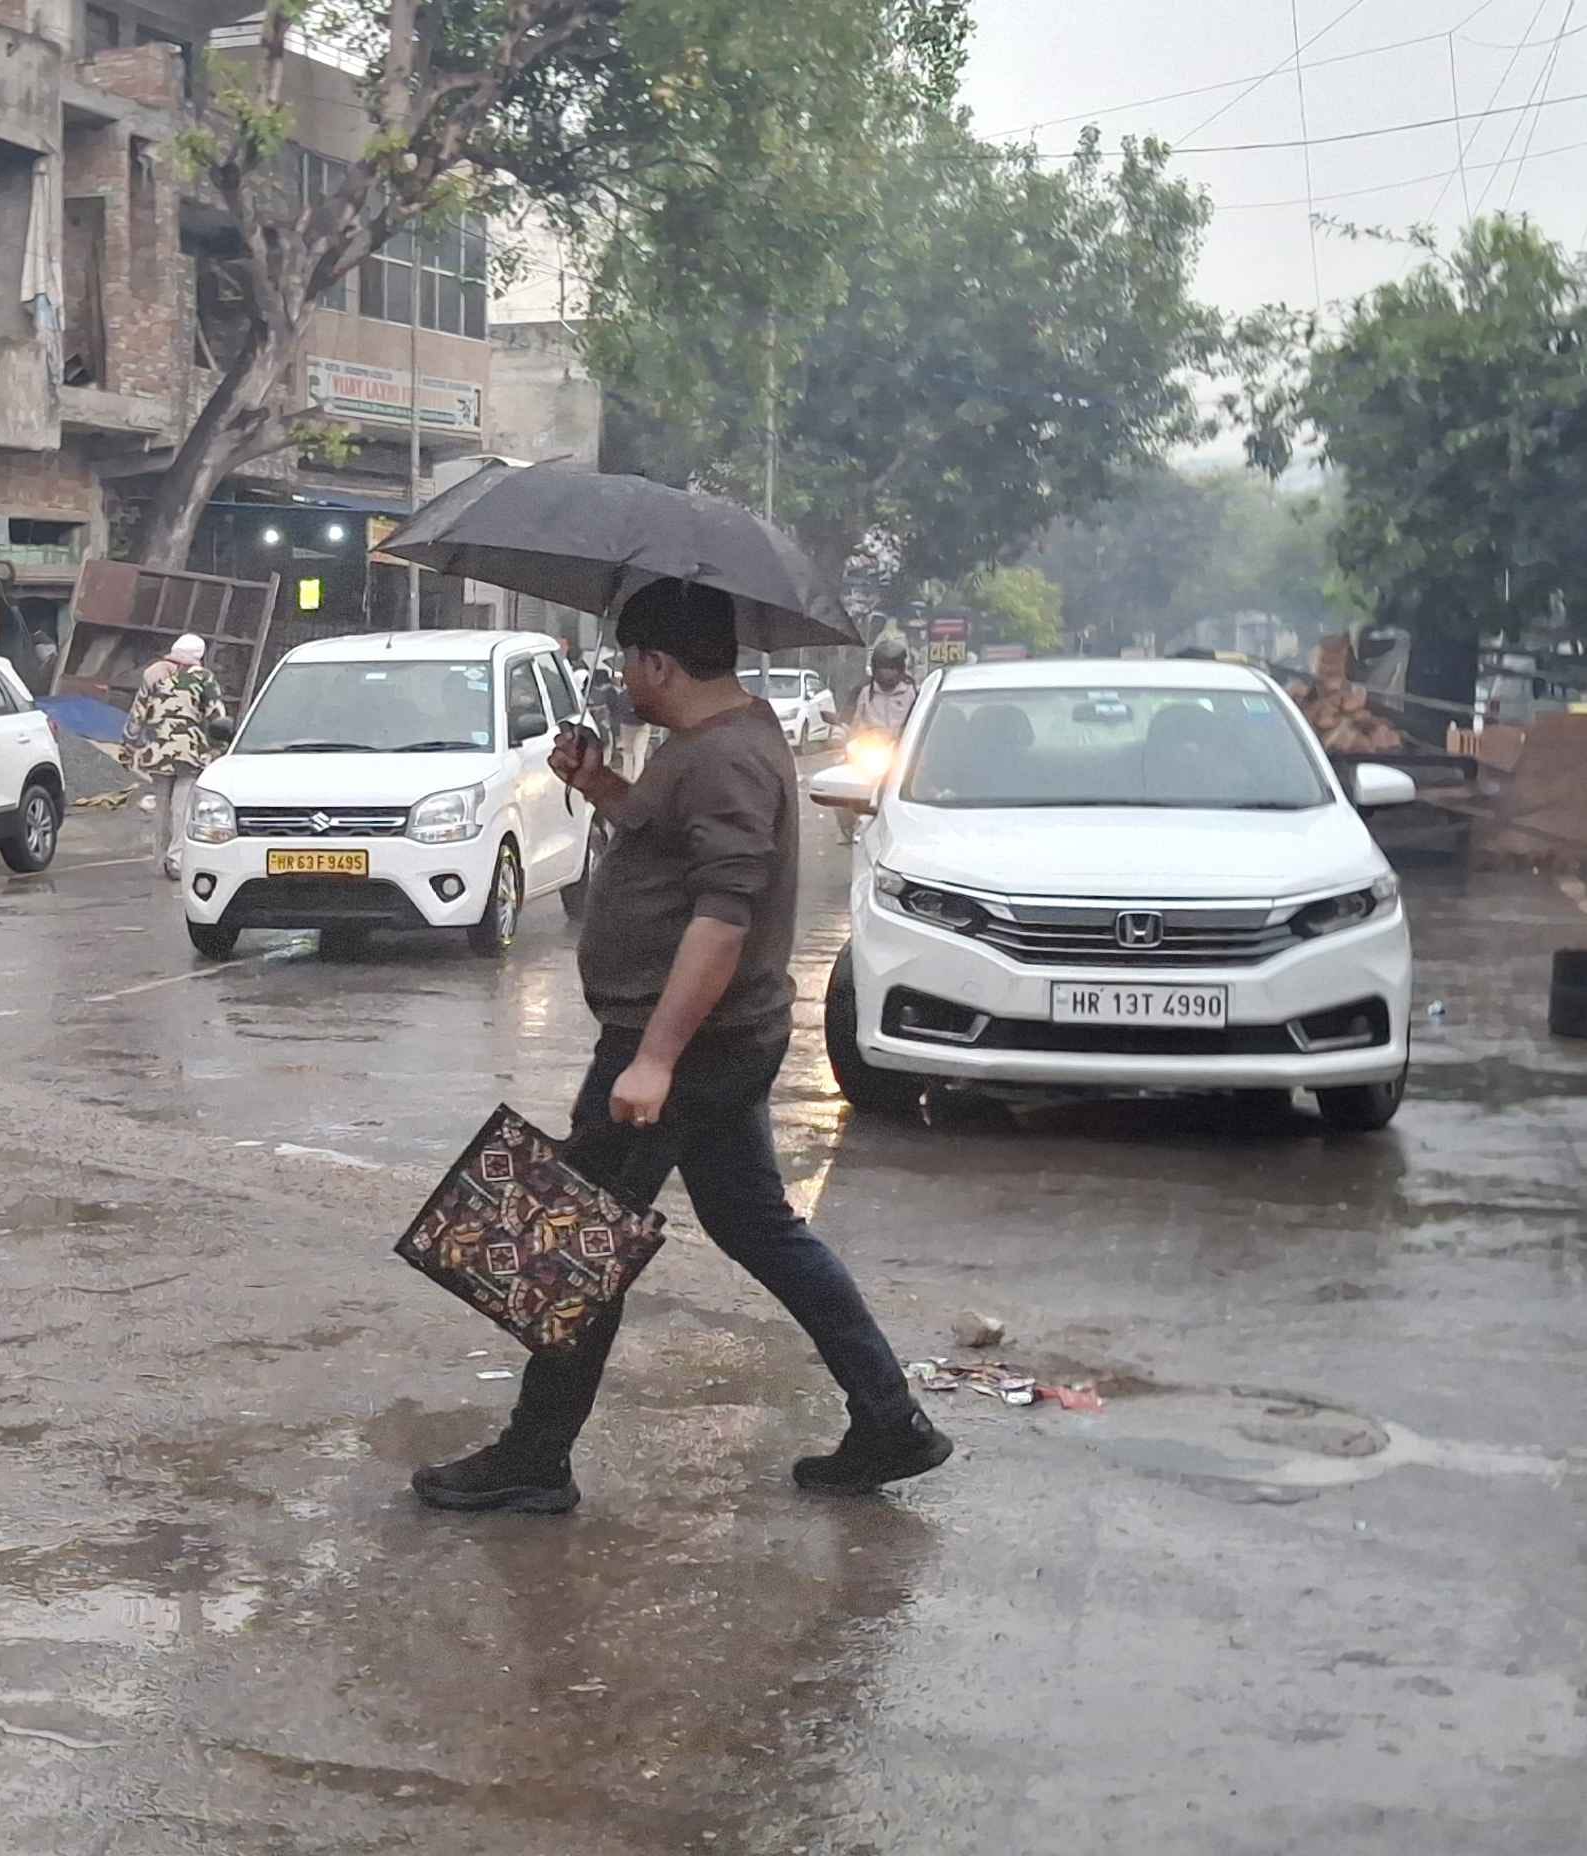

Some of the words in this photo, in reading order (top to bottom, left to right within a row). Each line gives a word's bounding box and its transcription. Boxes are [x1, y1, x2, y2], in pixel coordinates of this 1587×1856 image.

[277, 855, 294, 870] HR
[297, 855, 314, 870] 63
[317, 855, 324, 869] F
[327, 855, 362, 870] 9495
[1072, 991, 1101, 1015] HR
[1114, 992, 1154, 1016] 13T
[1163, 993, 1222, 1017] 4990
